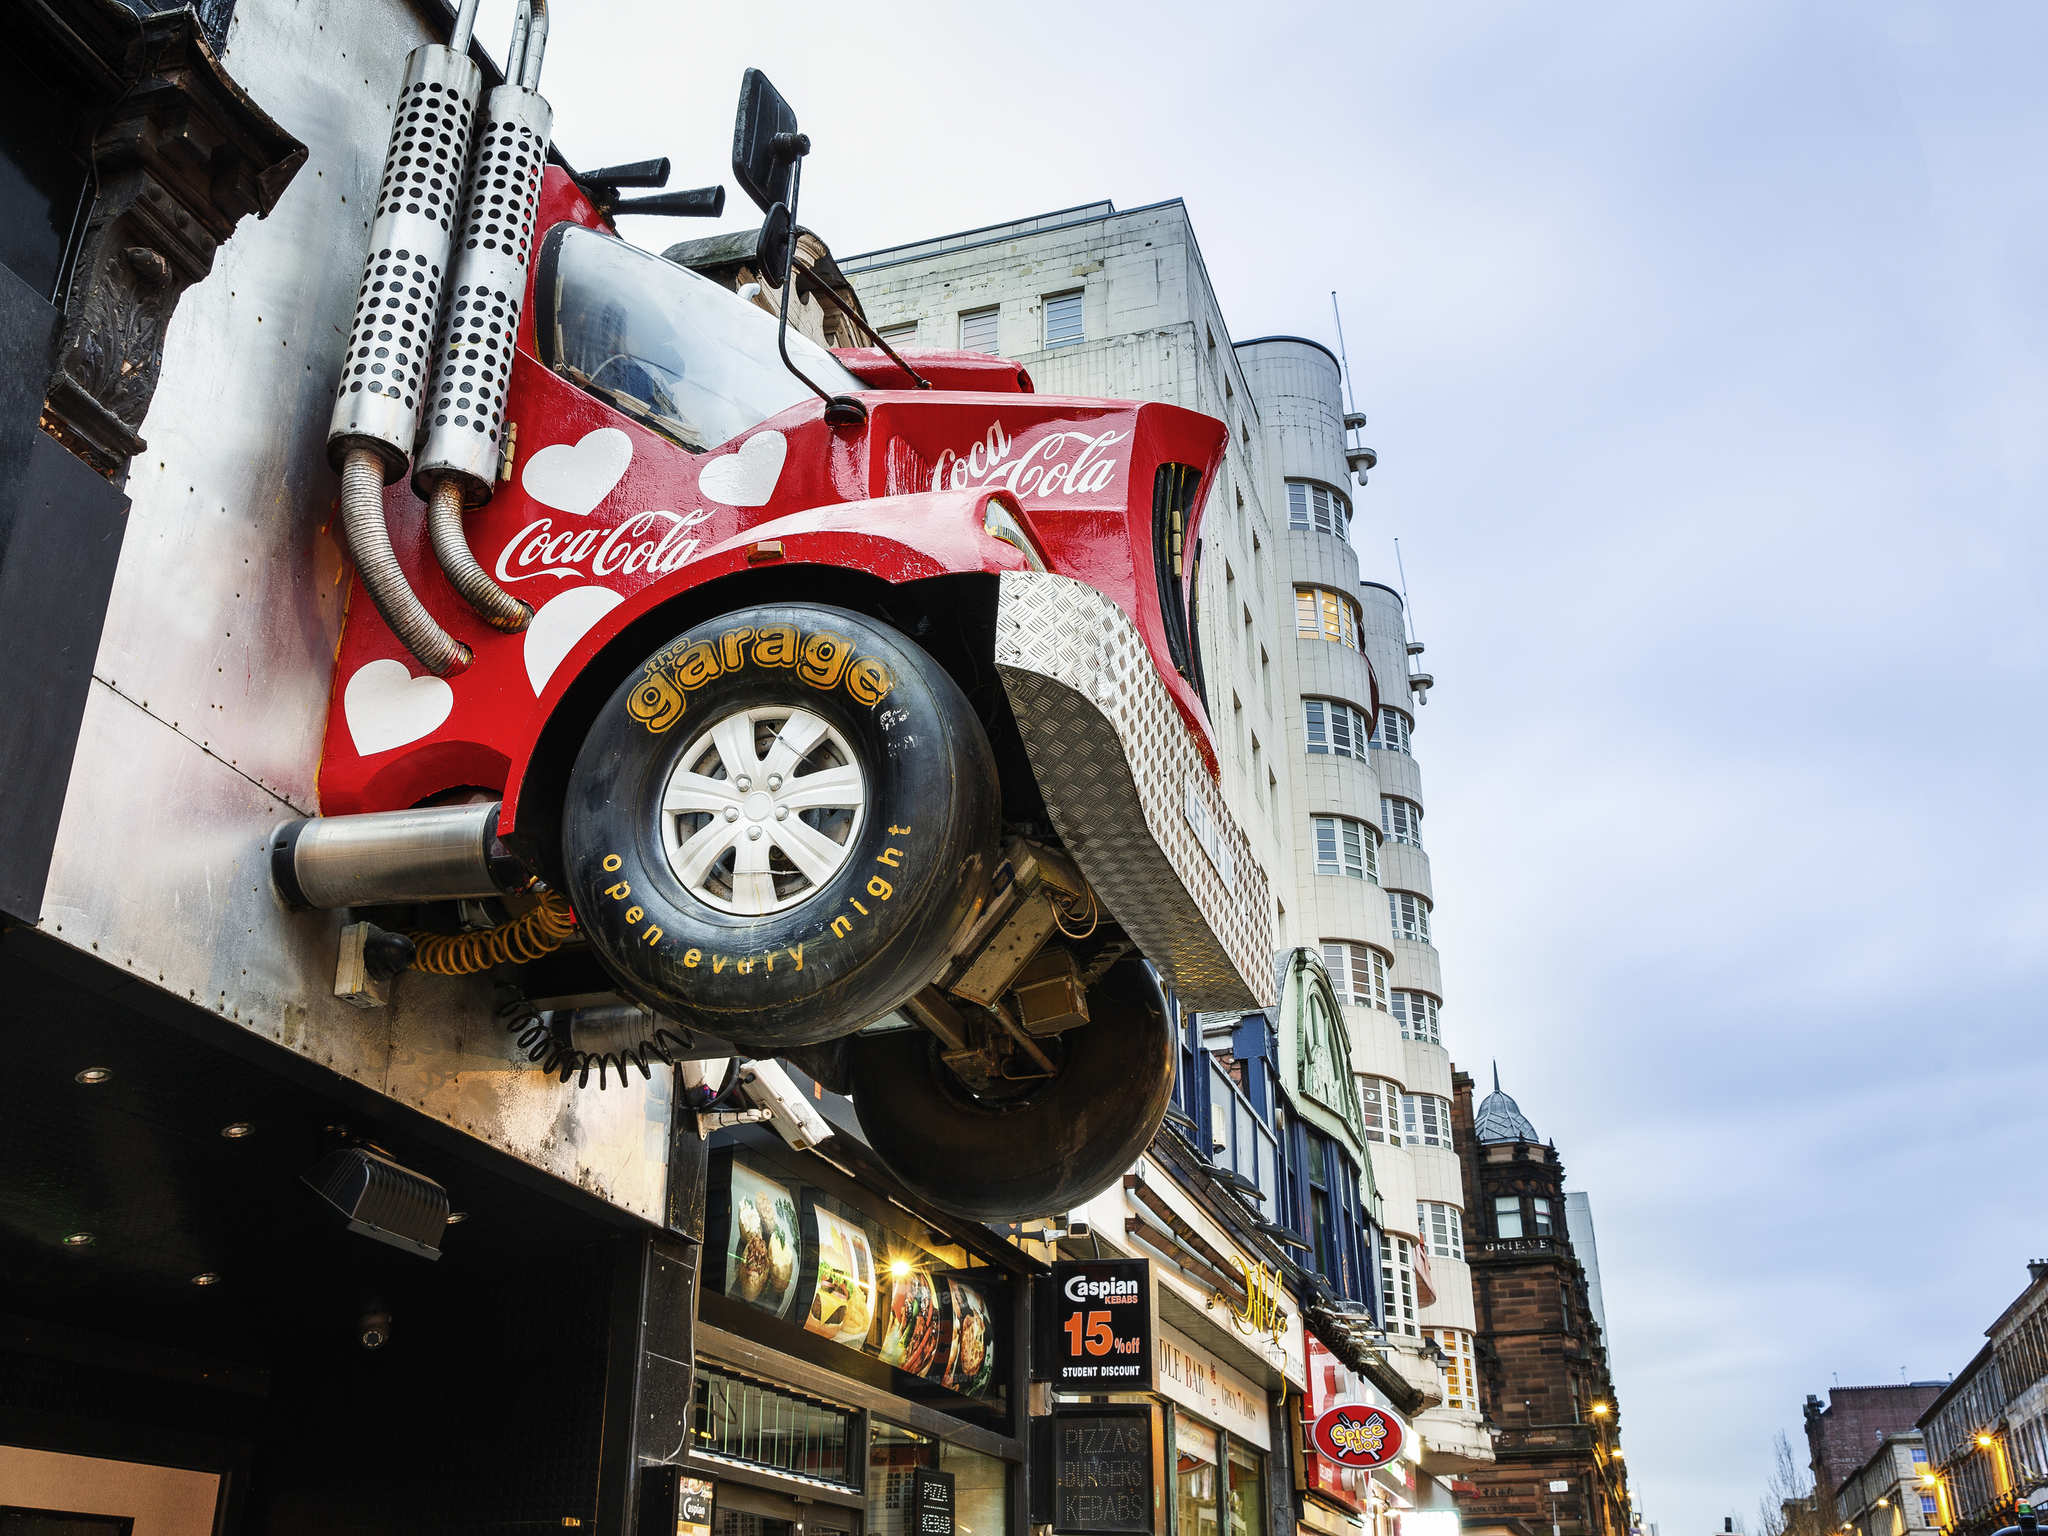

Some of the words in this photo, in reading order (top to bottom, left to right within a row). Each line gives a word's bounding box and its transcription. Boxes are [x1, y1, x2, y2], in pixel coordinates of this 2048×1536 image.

[645, 638, 690, 674] the
[627, 622, 896, 733] garage
[602, 854, 663, 947] open
[684, 943, 804, 975] every
[830, 824, 911, 939] night
[1064, 1275, 1139, 1303] Caspian
[1105, 1295, 1139, 1304] KEBABS
[1064, 1310, 1114, 1357] 15
[1062, 1366, 1098, 1378] STUDENT
[1101, 1365, 1141, 1377] DISCOUNT
[1185, 1355, 1205, 1398] BAR
[1065, 1427, 1141, 1454] PIZZAS
[1332, 1422, 1386, 1448] Spice
[1065, 1460, 1144, 1487] BURGERS
[1065, 1494, 1144, 1521] KEBABS
